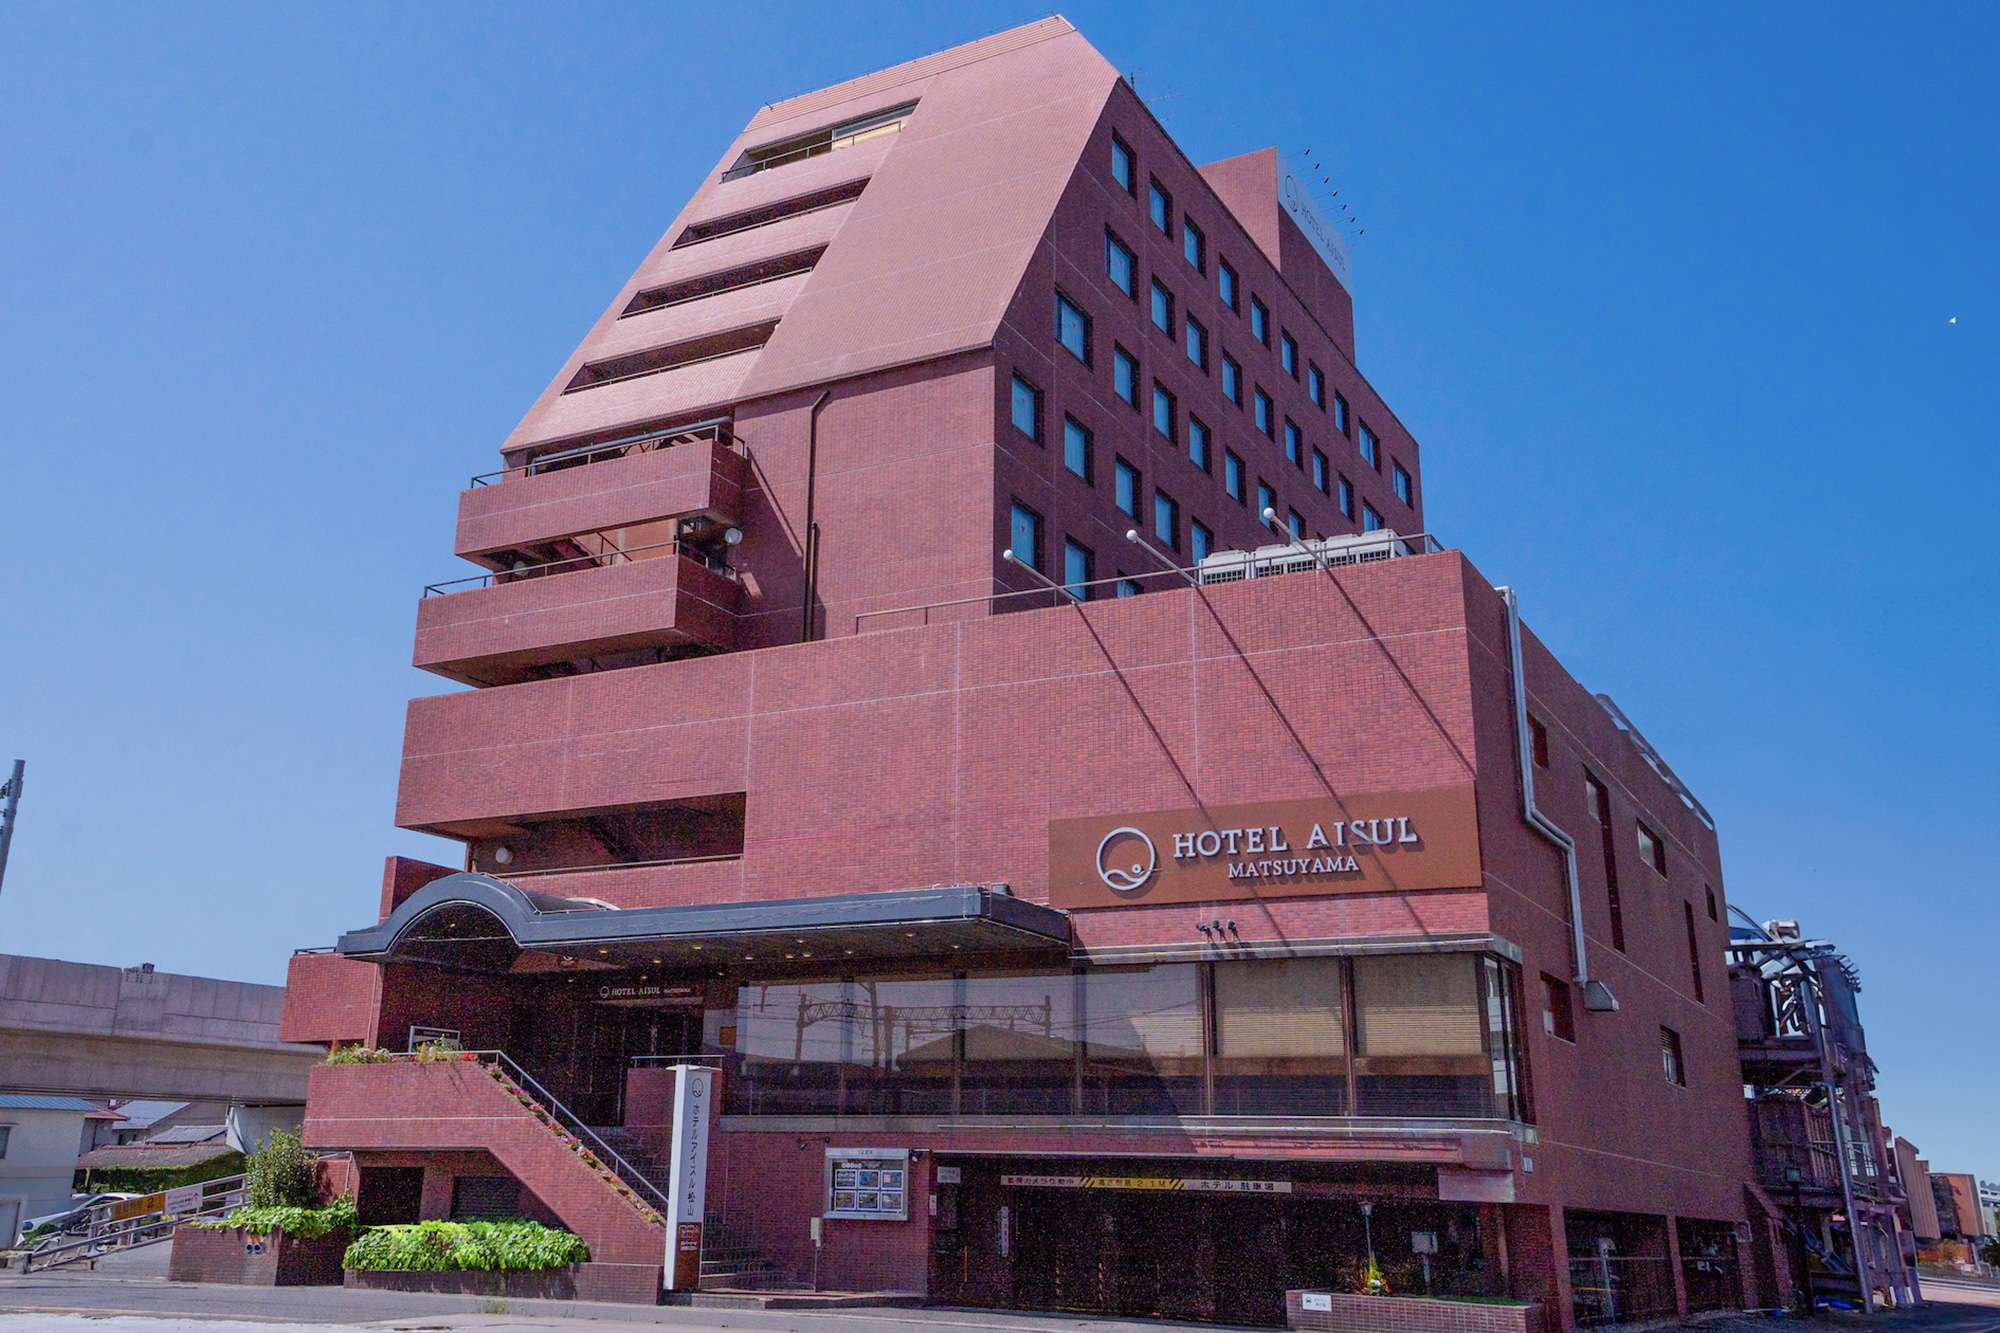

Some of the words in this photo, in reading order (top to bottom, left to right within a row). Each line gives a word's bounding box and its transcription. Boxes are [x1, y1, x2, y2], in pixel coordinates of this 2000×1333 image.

[1173, 826, 1288, 858] HOTEL
[1306, 816, 1419, 850] AISUL
[1228, 855, 1360, 879] MATSUYAMA
[612, 987, 636, 995] HOTEL
[687, 1104, 700, 1216] ホテルアイスル松山
[1200, 1180, 1233, 1190] ホテル
[1240, 1182, 1274, 1191] 駐車場
